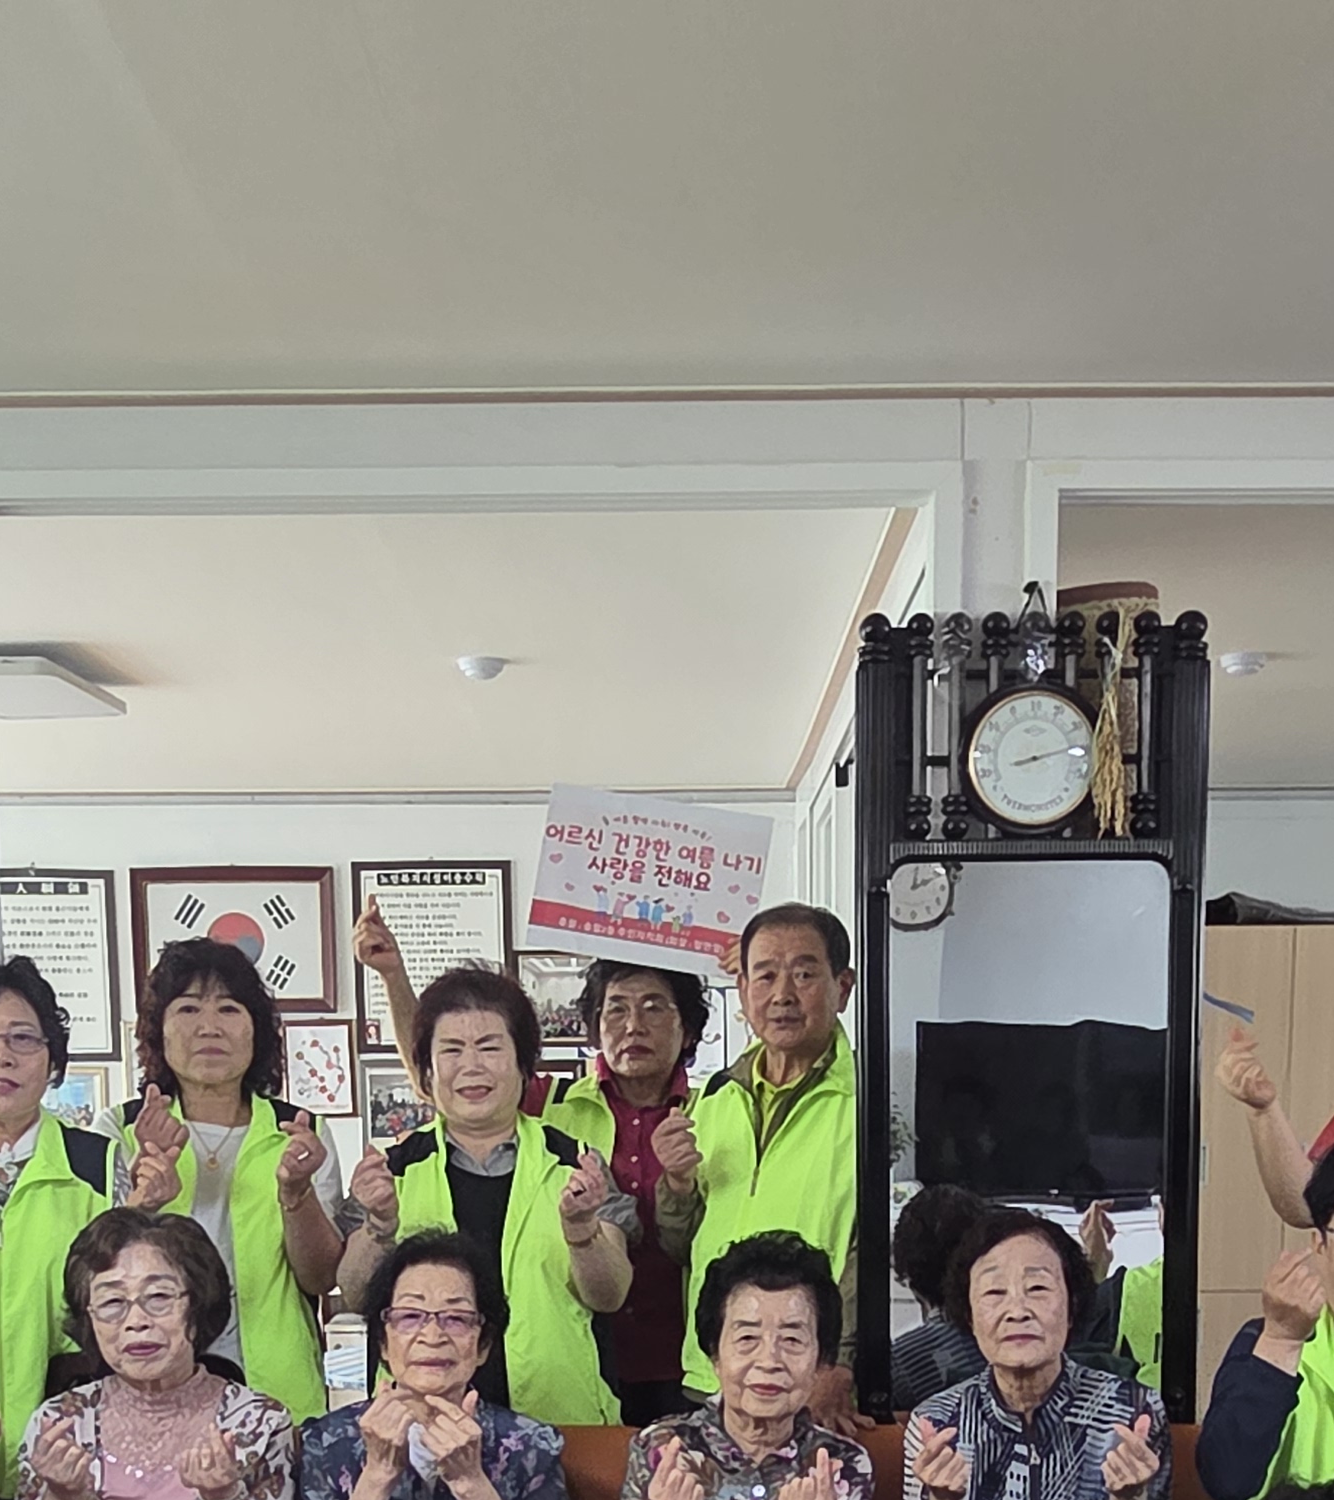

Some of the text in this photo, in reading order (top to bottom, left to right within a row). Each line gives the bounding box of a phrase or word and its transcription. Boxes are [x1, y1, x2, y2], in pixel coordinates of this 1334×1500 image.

[545, 823, 604, 851] 어르신
[611, 832, 672, 861] 건강한
[677, 845, 716, 871] 여름
[722, 853, 762, 875] 나기
[588, 855, 712, 892] 사랑을 전해요
